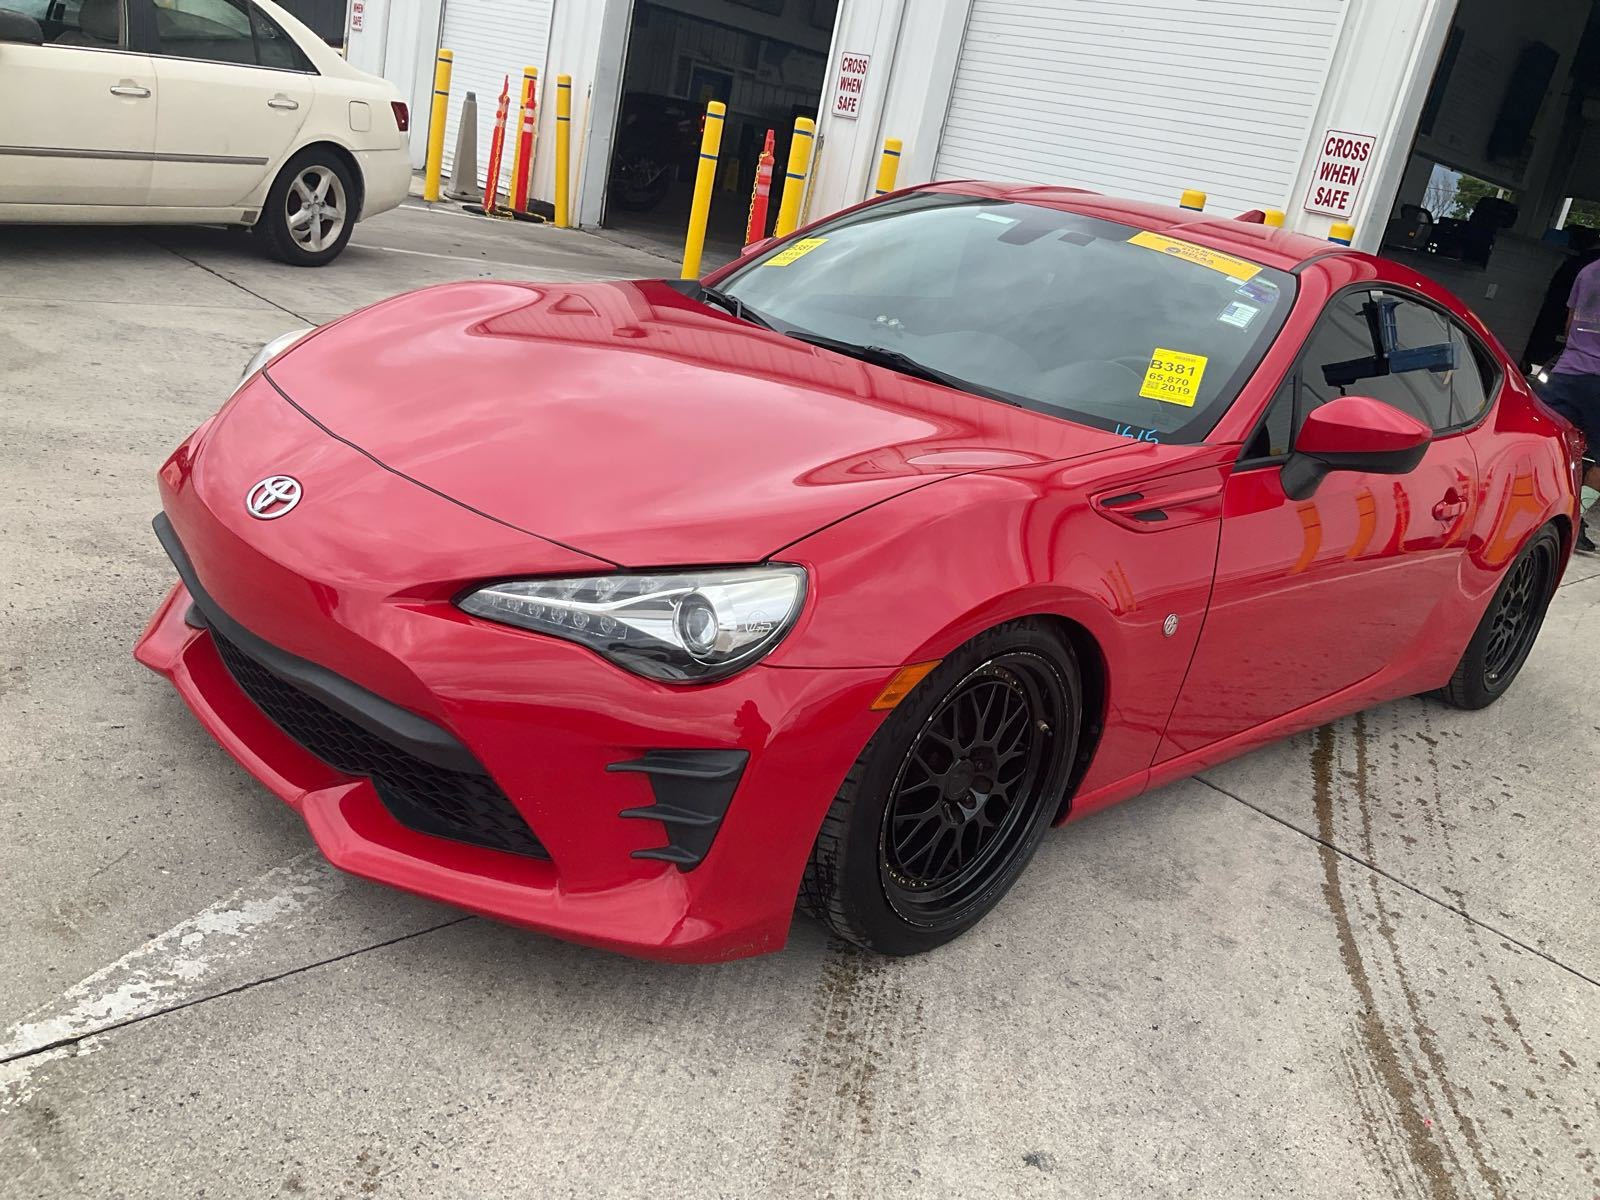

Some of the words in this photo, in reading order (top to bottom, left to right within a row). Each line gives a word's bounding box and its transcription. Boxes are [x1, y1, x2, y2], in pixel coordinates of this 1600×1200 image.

[842, 57, 867, 74] CROSS
[840, 76, 862, 93] WHEN
[837, 95, 857, 112] SAFE
[1325, 137, 1370, 161] CROSS
[1319, 162, 1360, 186] WHEN
[1314, 187, 1350, 210] SAFE
[1149, 359, 1195, 376] B381
[1161, 383, 1190, 395] 2019
